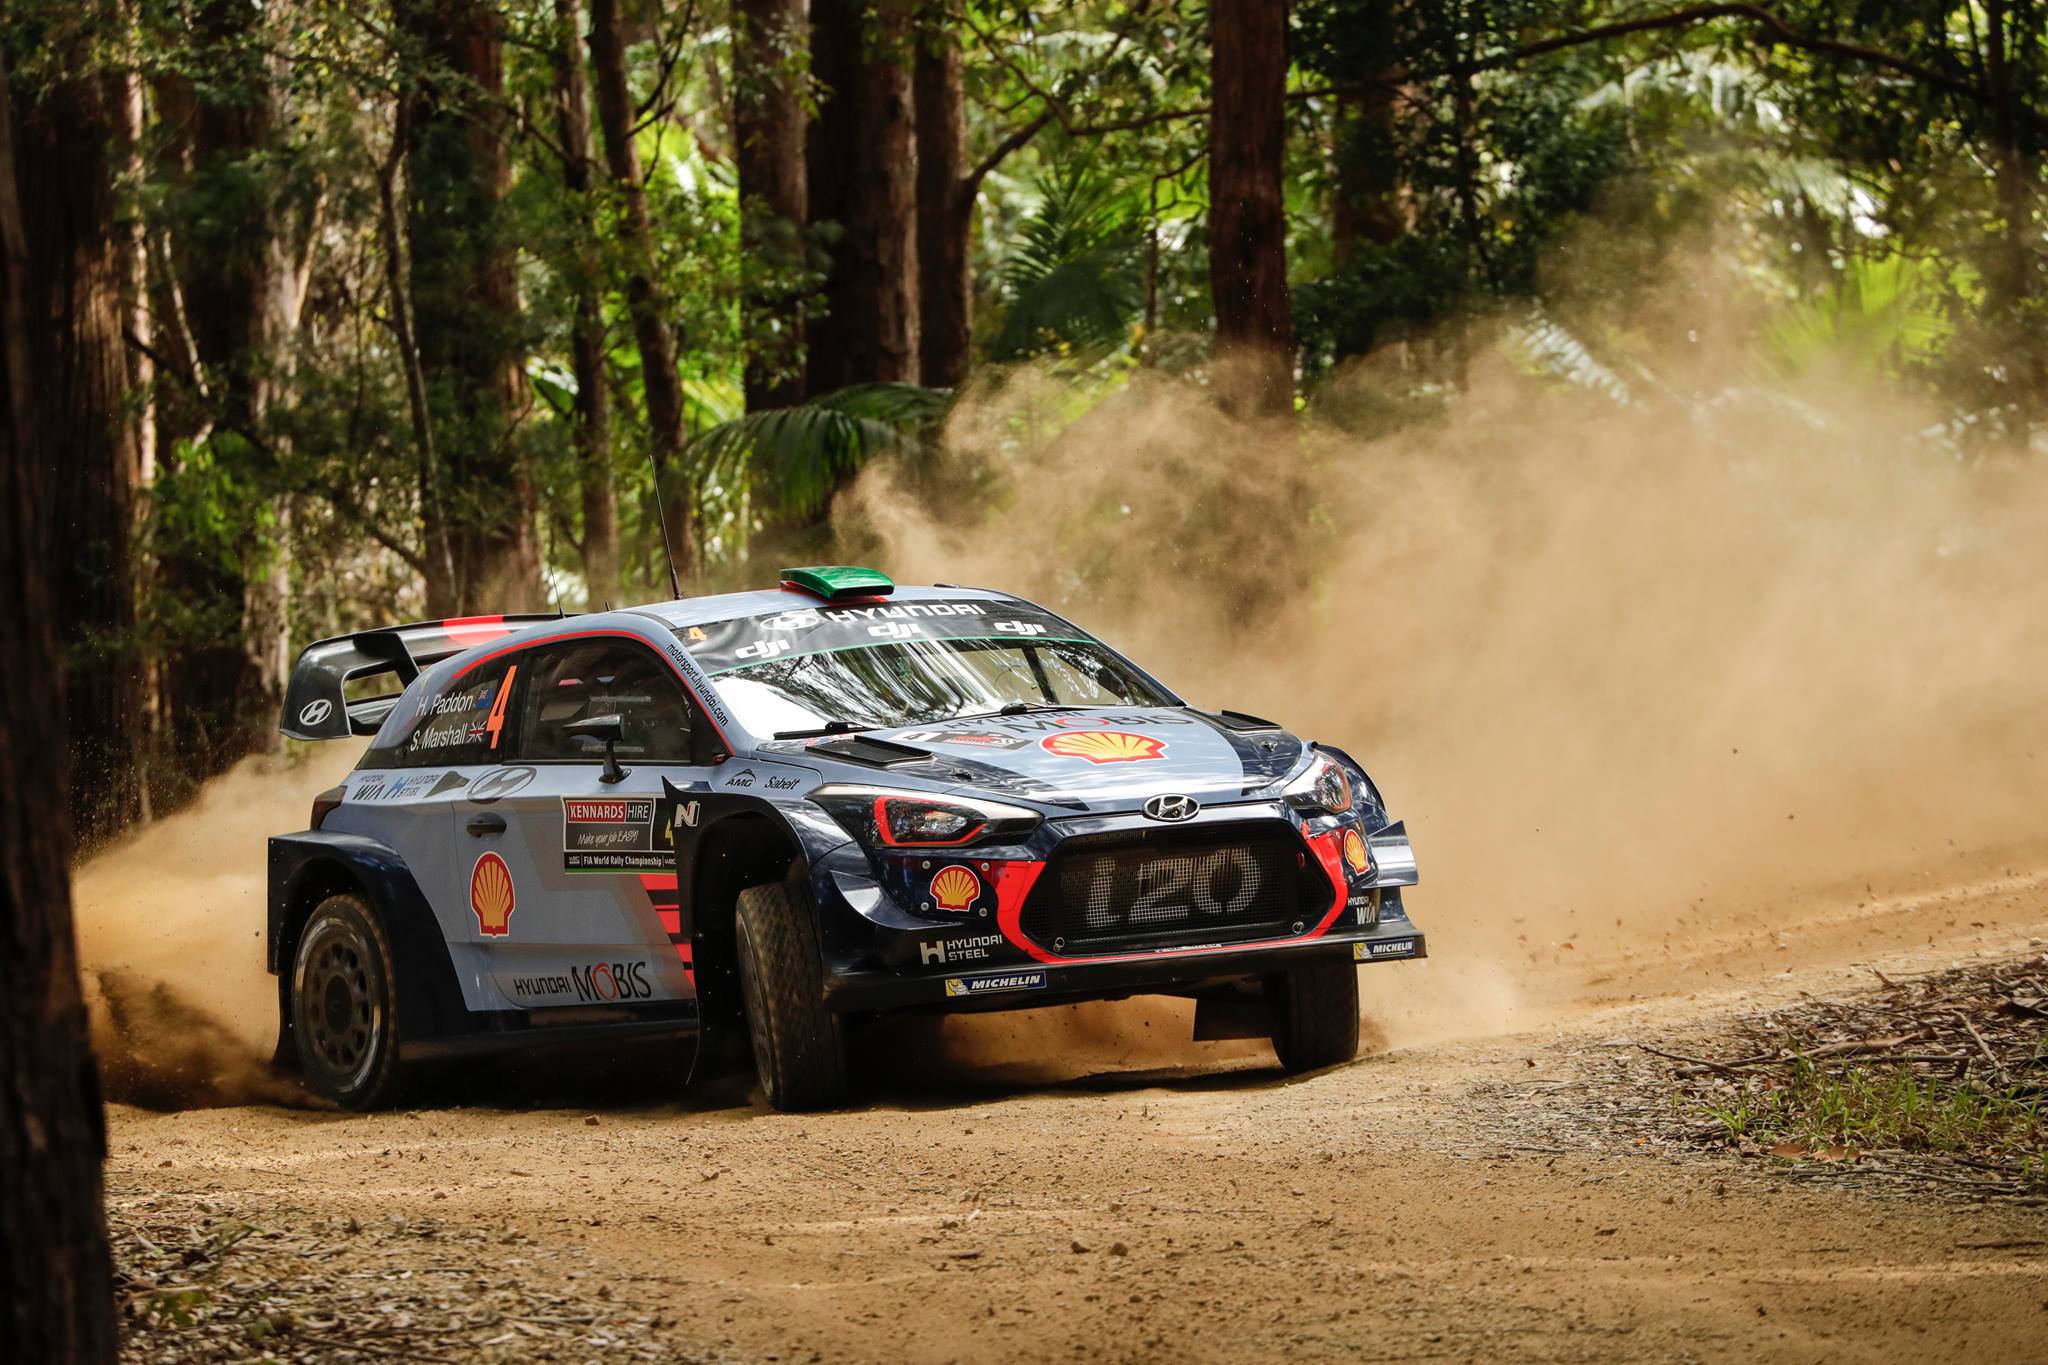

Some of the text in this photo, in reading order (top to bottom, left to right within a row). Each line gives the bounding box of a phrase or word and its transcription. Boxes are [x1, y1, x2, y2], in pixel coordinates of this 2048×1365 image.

[825, 604, 986, 623] HYUNDAI
[688, 626, 708, 641] 4
[666, 643, 729, 727] motorsport.hyundai.com
[415, 691, 474, 717] H. Paddon
[485, 664, 518, 750] 4
[944, 711, 1086, 729] HYUNDAI
[1001, 715, 1195, 733] MOBIS
[410, 723, 468, 752] S. Marshall
[352, 782, 386, 801] WIA
[725, 778, 753, 788] AMG
[764, 776, 800, 790] Sabelt
[570, 803, 649, 820] KENNARDS HIRE
[577, 833, 595, 846] Make
[595, 834, 608, 848] your
[606, 831, 618, 847] job
[583, 855, 662, 867] FIA World Rally Championship
[1356, 903, 1376, 925] WIA
[947, 935, 1003, 950] HYUNDAI
[1373, 941, 1413, 954] MICHELIN
[948, 948, 989, 961] STEEL
[514, 961, 652, 1001] HYUNDAI MOBIS
[971, 975, 1041, 990] MICHELIN
